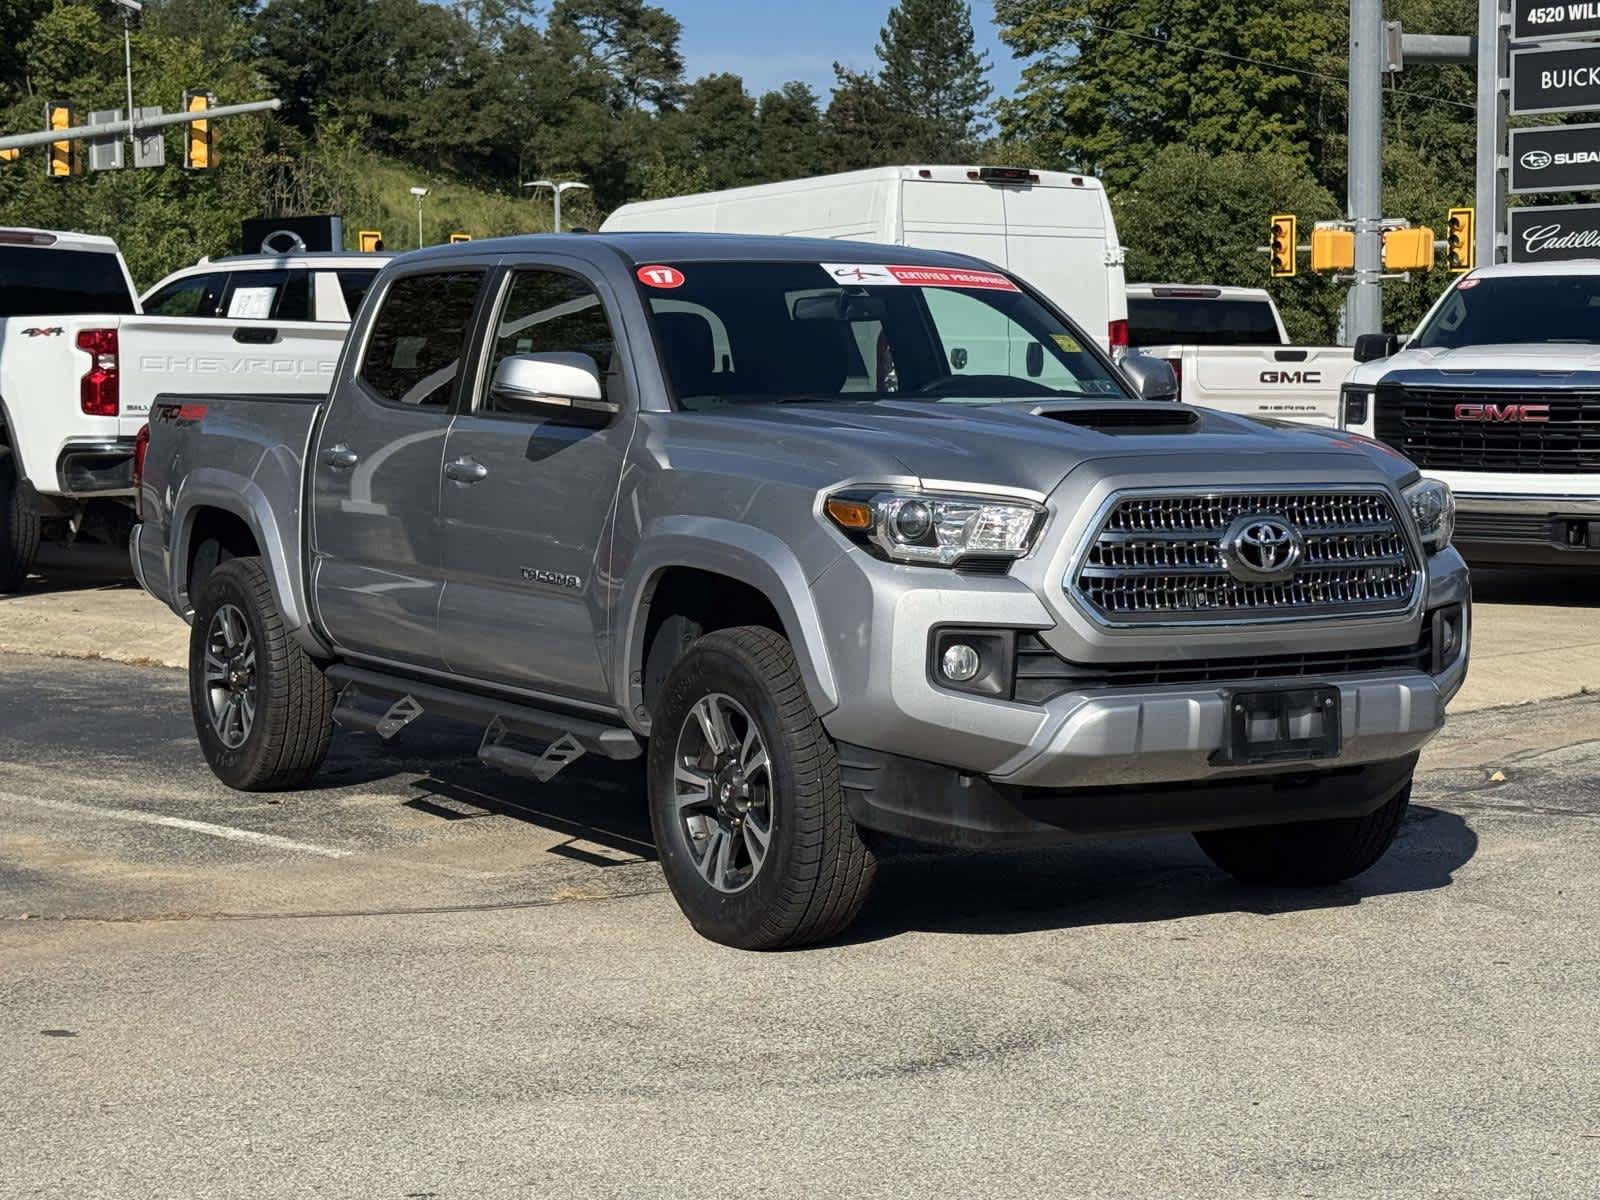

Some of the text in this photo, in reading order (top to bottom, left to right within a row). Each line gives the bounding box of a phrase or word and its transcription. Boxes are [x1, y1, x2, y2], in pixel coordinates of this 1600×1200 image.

[1528, 6, 1565, 24] 4520
[1541, 67, 1600, 89] BUICK
[644, 270, 673, 284] 17
[895, 271, 949, 281] CERTIFIED
[1259, 371, 1321, 384] GMC
[1455, 403, 1550, 423] GMC
